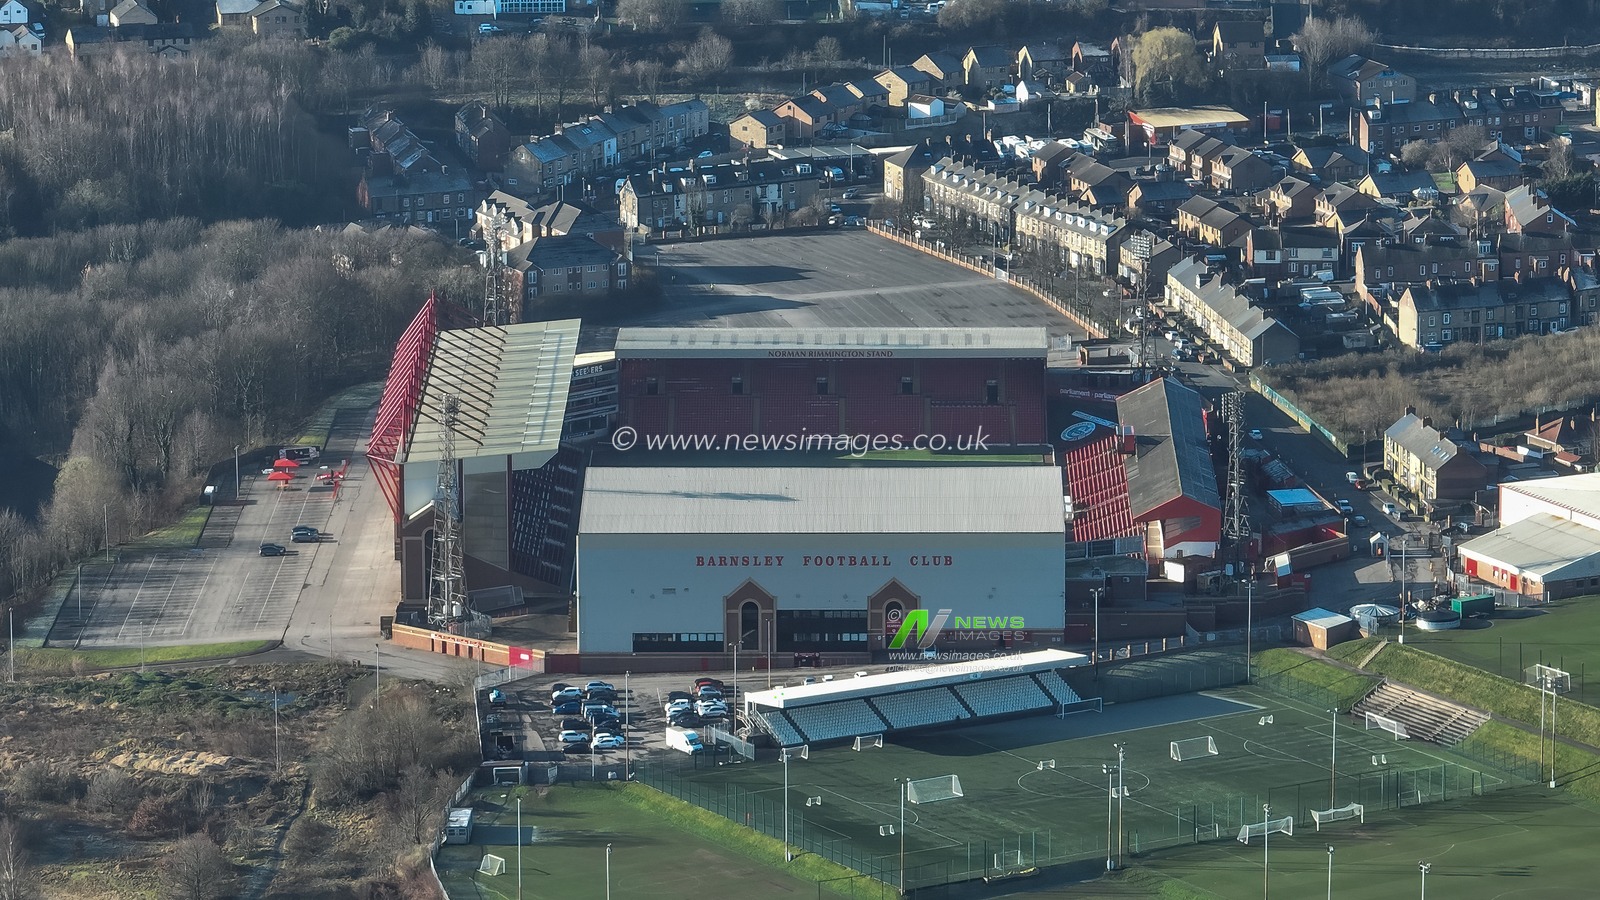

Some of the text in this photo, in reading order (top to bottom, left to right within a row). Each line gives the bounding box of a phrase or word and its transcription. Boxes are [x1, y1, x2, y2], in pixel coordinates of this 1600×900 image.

[768, 350, 894, 358] NORMAN RIMMINGTON STAND
[696, 555, 953, 567] BARNSLEY FOOTBALL CLUB
